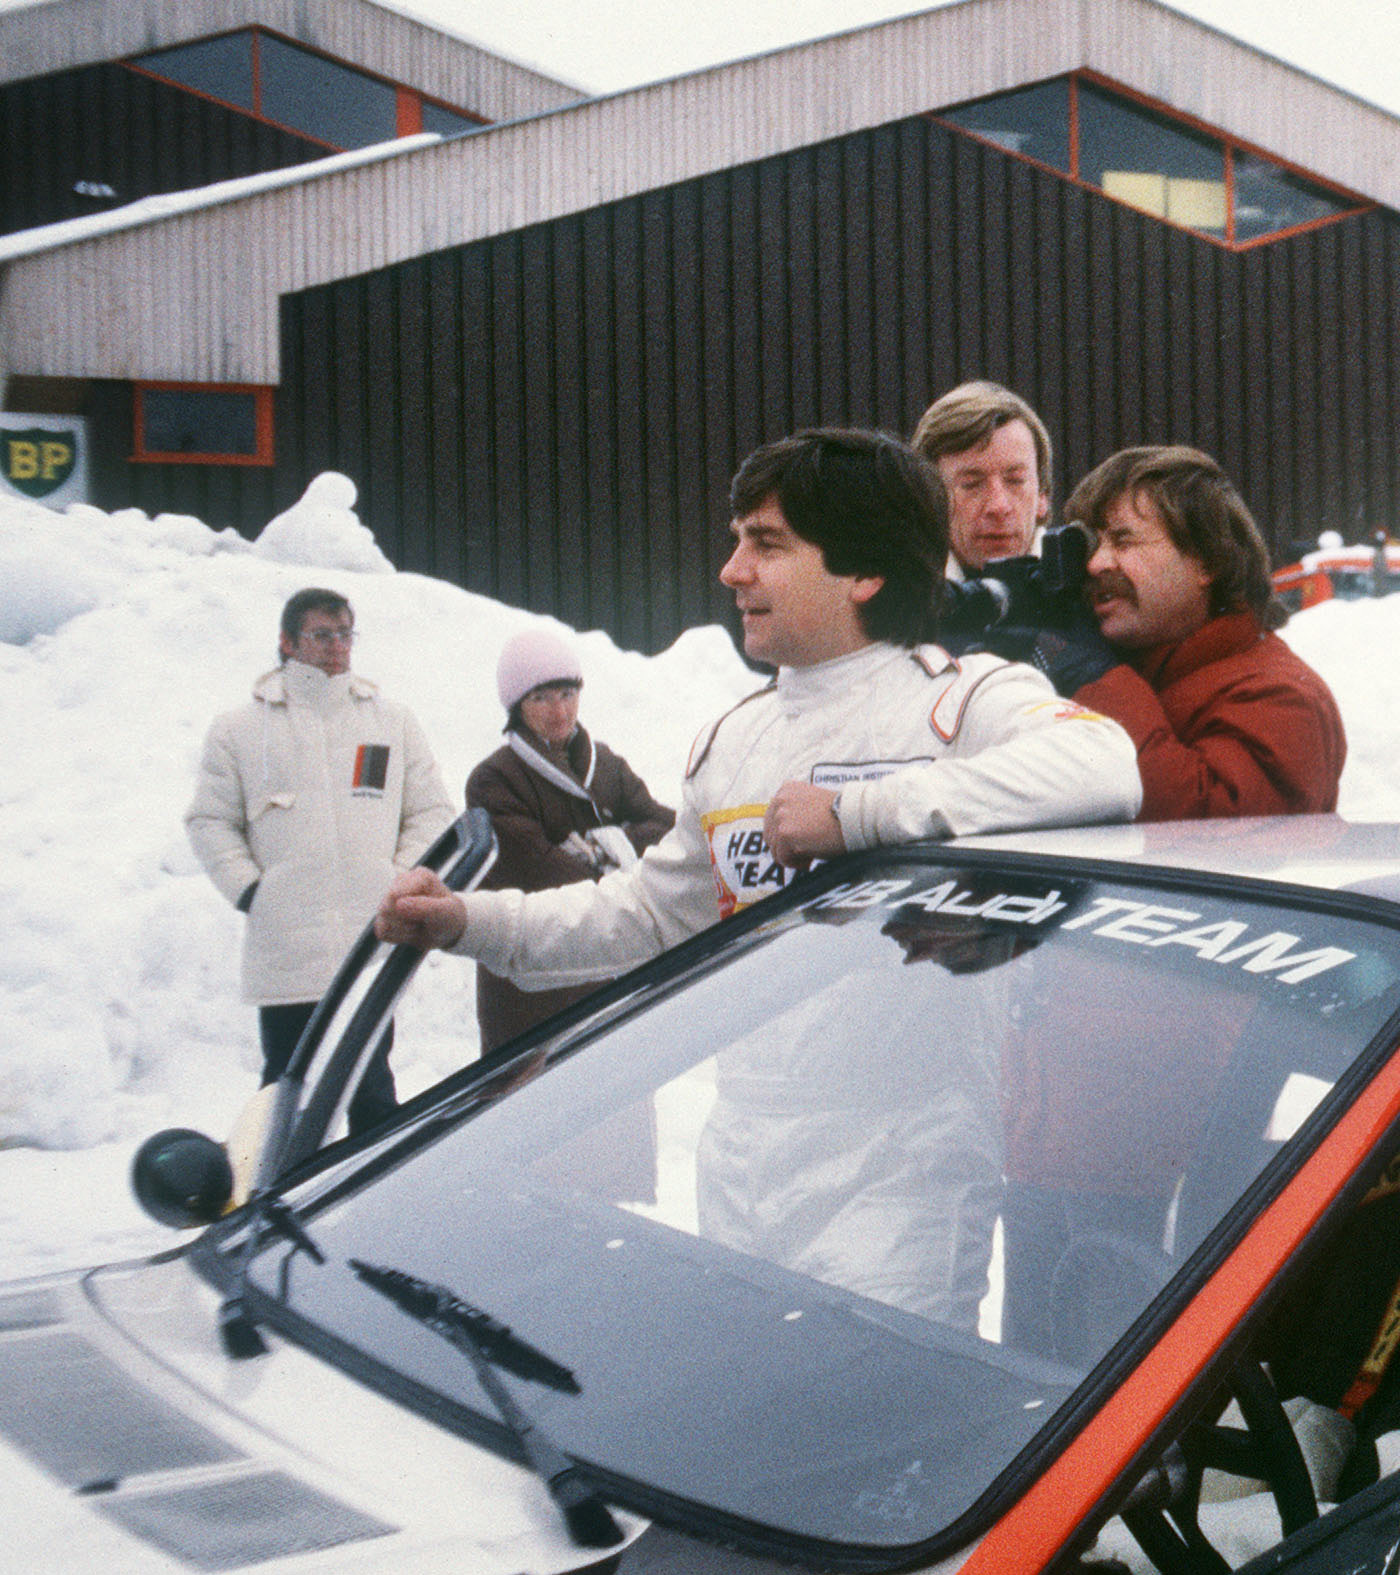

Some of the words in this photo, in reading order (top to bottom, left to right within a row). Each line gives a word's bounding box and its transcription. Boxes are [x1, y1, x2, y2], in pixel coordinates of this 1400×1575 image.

[9, 440, 71, 480] BP
[735, 861, 785, 887] TEA
[794, 880, 912, 911] HB
[890, 880, 1067, 925] Audi
[1060, 897, 1357, 984] TEAM
